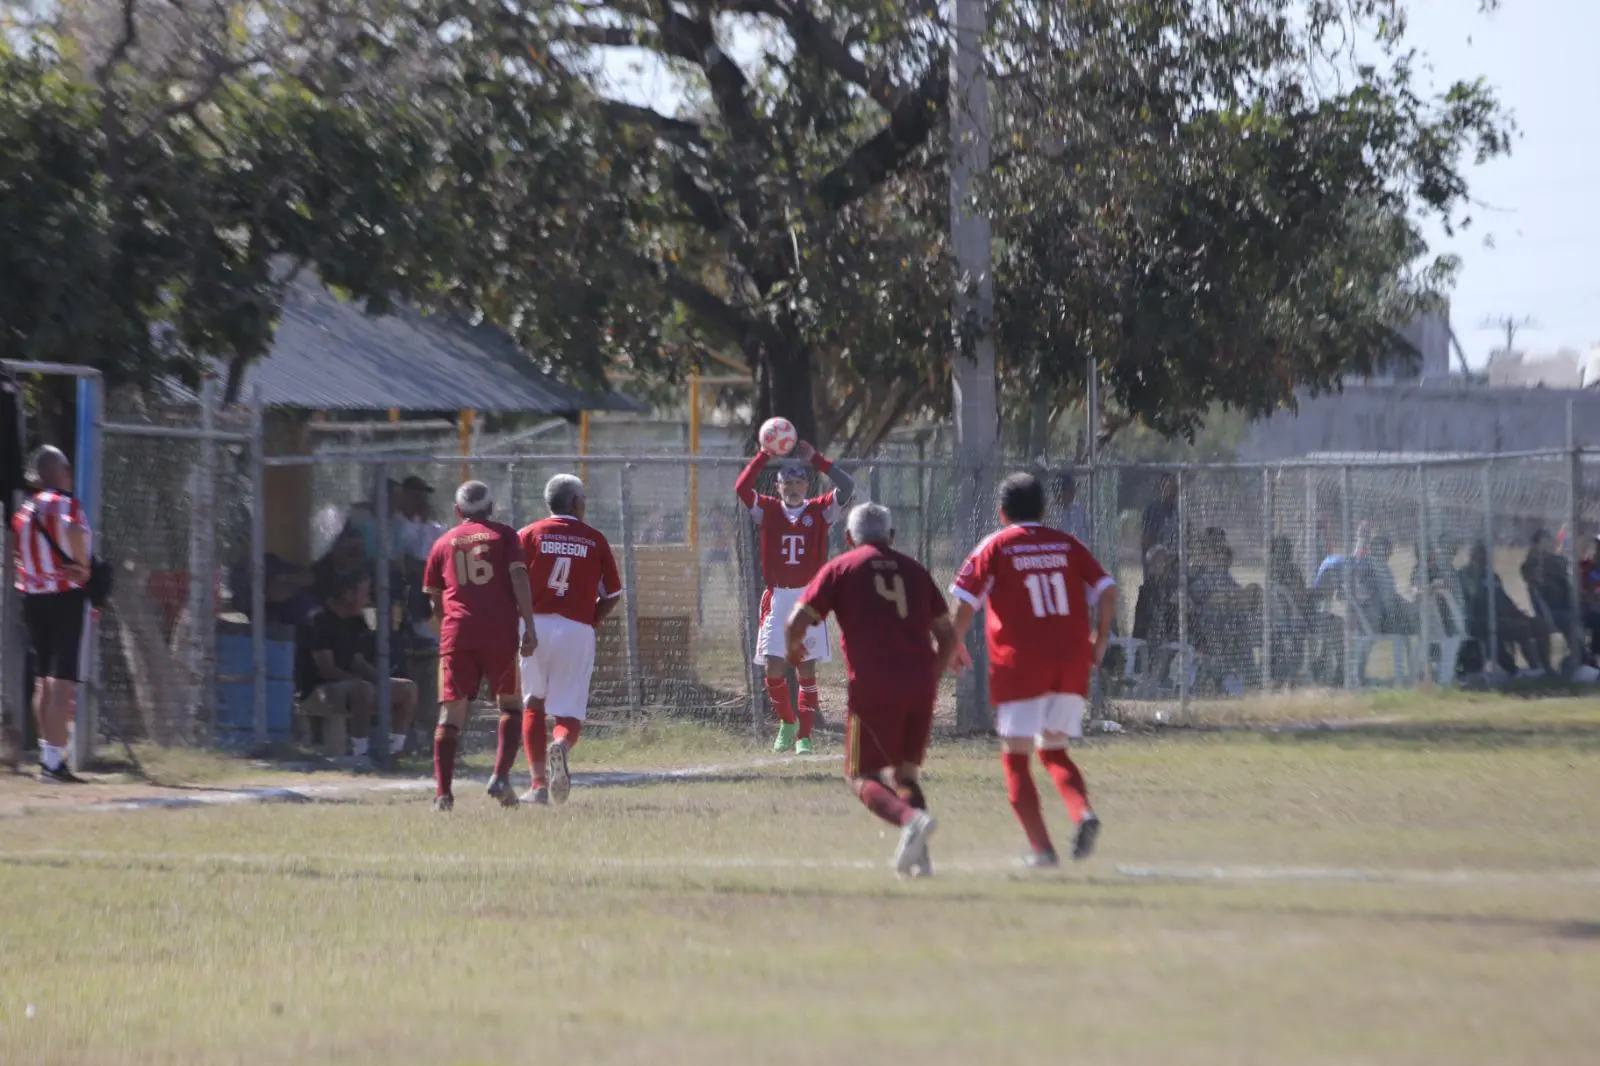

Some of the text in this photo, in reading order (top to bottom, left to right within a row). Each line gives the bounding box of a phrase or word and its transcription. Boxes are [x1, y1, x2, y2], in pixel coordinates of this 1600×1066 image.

[455, 544, 494, 586] 16
[541, 541, 588, 558] OBREGON
[781, 535, 805, 565] T
[547, 557, 572, 597] 4
[873, 572, 909, 620] 4
